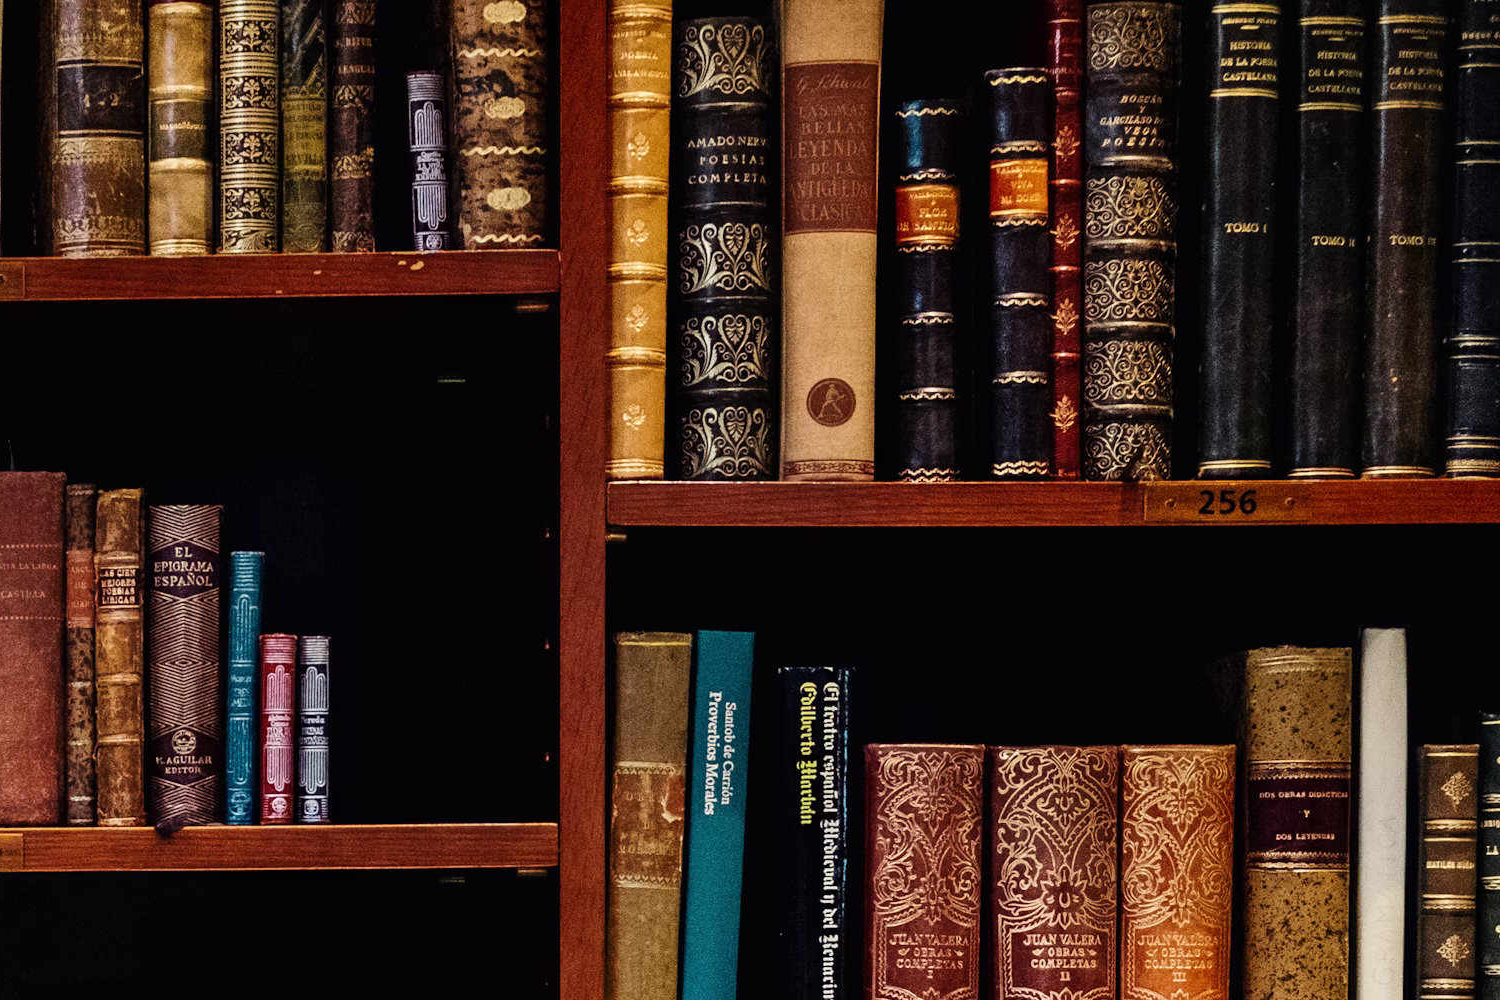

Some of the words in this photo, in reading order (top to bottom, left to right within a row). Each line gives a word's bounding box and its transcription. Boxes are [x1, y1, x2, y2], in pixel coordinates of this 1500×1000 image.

[1198, 489, 1257, 516] 256
[175, 546, 193, 558] EL
[154, 561, 213, 573] EPIGRAMA
[154, 573, 212, 587] ESPAÑOL
[706, 691, 723, 762] Proverbios
[724, 702, 737, 747] Santob
[723, 749, 735, 758] de
[165, 766, 202, 775] EDITOR
[721, 760, 735, 806] Carrión
[704, 764, 719, 816] Morales
[889, 934, 923, 946] JUAN
[926, 934, 970, 946] VALERA
[1023, 934, 1057, 946] JUAN
[1058, 934, 1101, 946] VALERA
[913, 948, 952, 957] OBRAS
[1048, 948, 1085, 957] OBRAS
[895, 958, 964, 970] COMPLETAS
[1030, 958, 1097, 970] COMPLETAS
